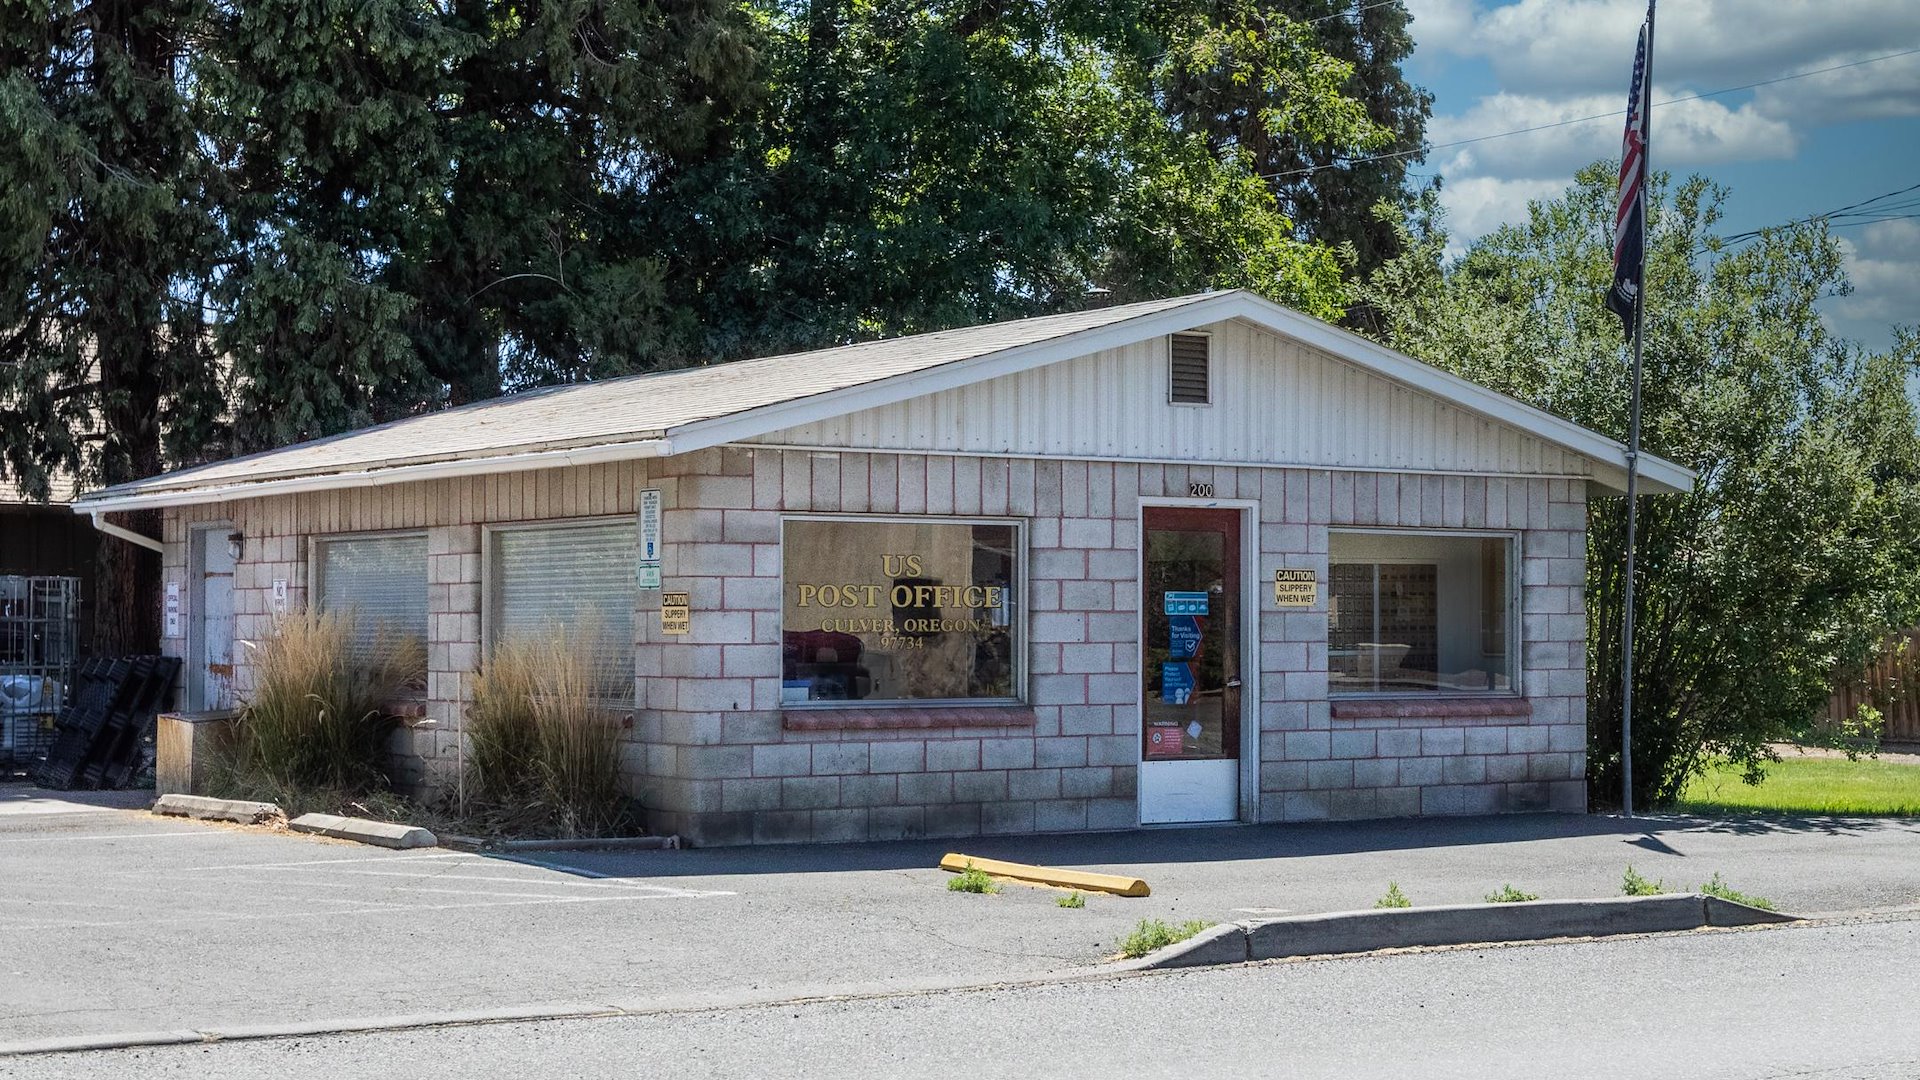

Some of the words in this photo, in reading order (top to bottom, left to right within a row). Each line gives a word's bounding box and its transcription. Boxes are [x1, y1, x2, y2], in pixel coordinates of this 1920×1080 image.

[1190, 484, 1213, 497] 200
[882, 554, 922, 577] US
[1276, 570, 1315, 581] CAUTION
[1279, 584, 1312, 592] SLIPPERY
[663, 594, 687, 606] CAUTION
[798, 584, 882, 608] POST
[890, 584, 1002, 608] OFFICE
[1276, 594, 1298, 602] WHEN
[1300, 594, 1316, 603] WET
[664, 609, 686, 618] SLIPPERY
[662, 622, 677, 630] WHEN
[678, 622, 688, 630] WET
[821, 618, 900, 634] CULVER,
[904, 618, 982, 632] OREGON
[880, 636, 924, 650] 97734
